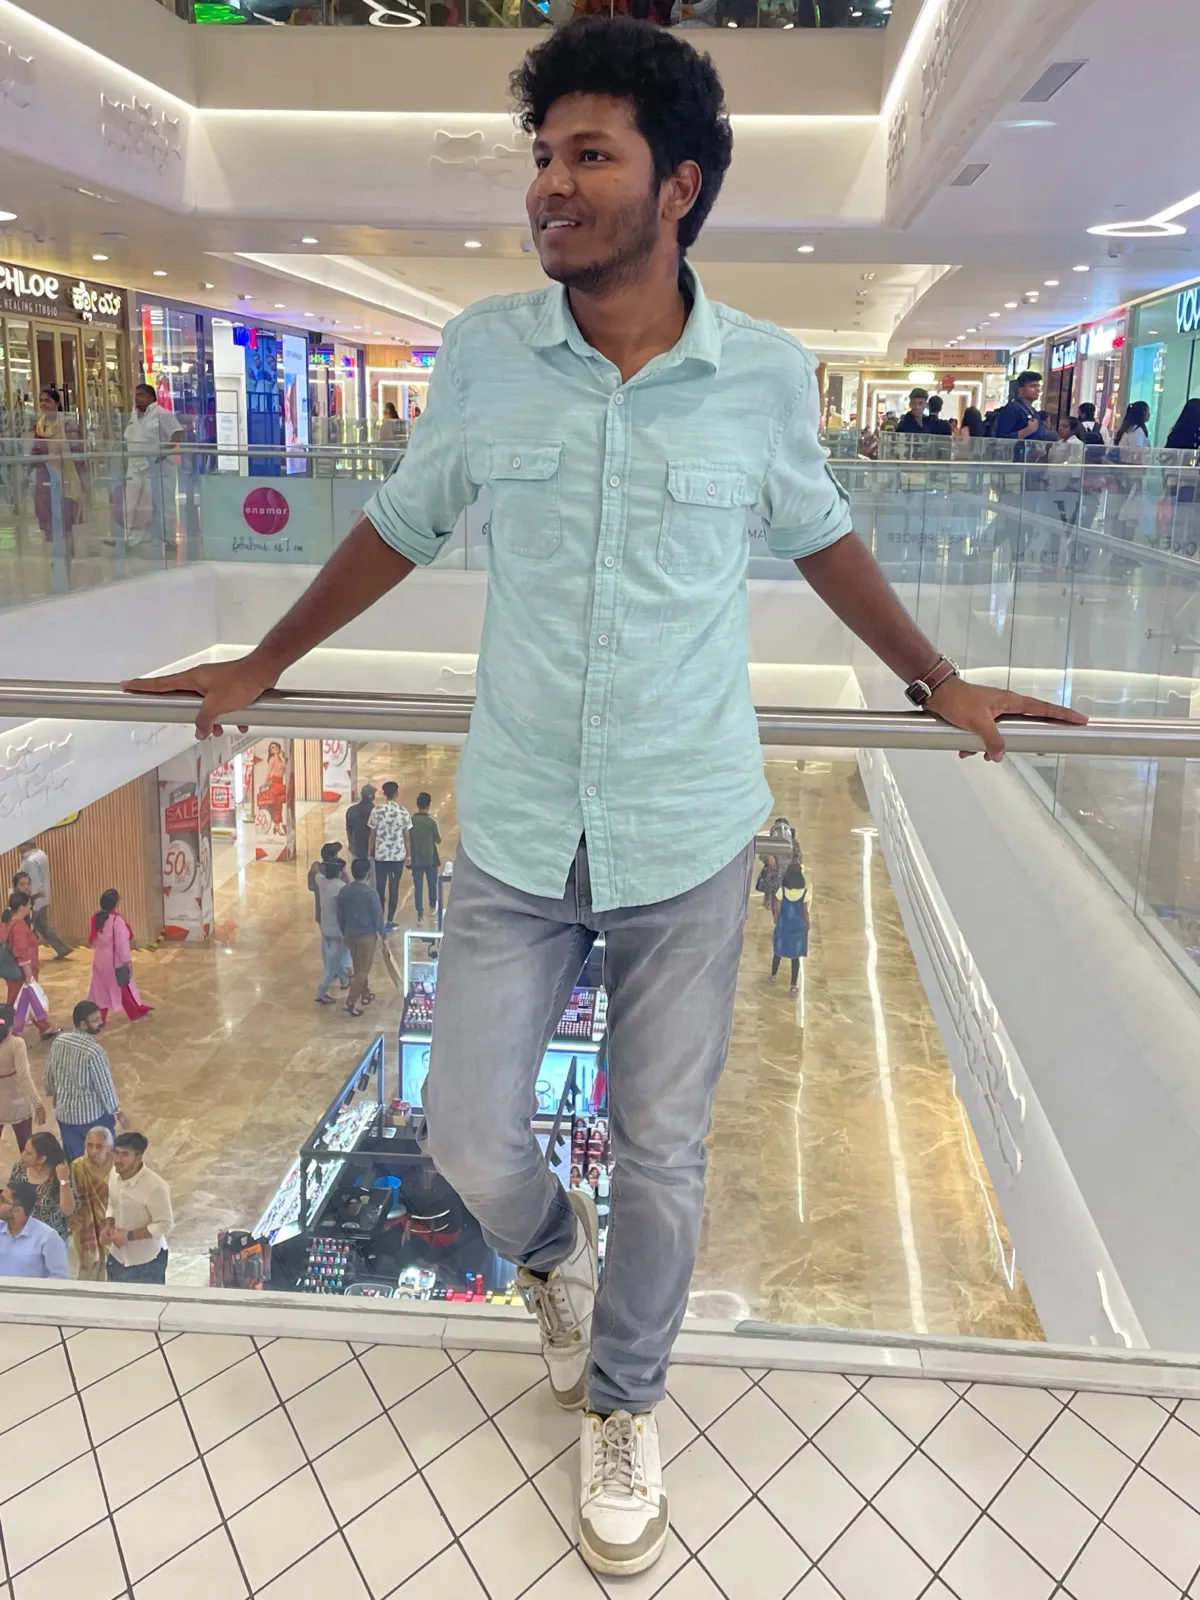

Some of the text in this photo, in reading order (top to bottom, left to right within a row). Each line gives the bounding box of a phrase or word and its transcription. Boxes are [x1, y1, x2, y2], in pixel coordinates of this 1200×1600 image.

[4, 299, 58, 317] HEALING STUDIO
[245, 507, 288, 515] enamor
[166, 801, 199, 821] SALE
